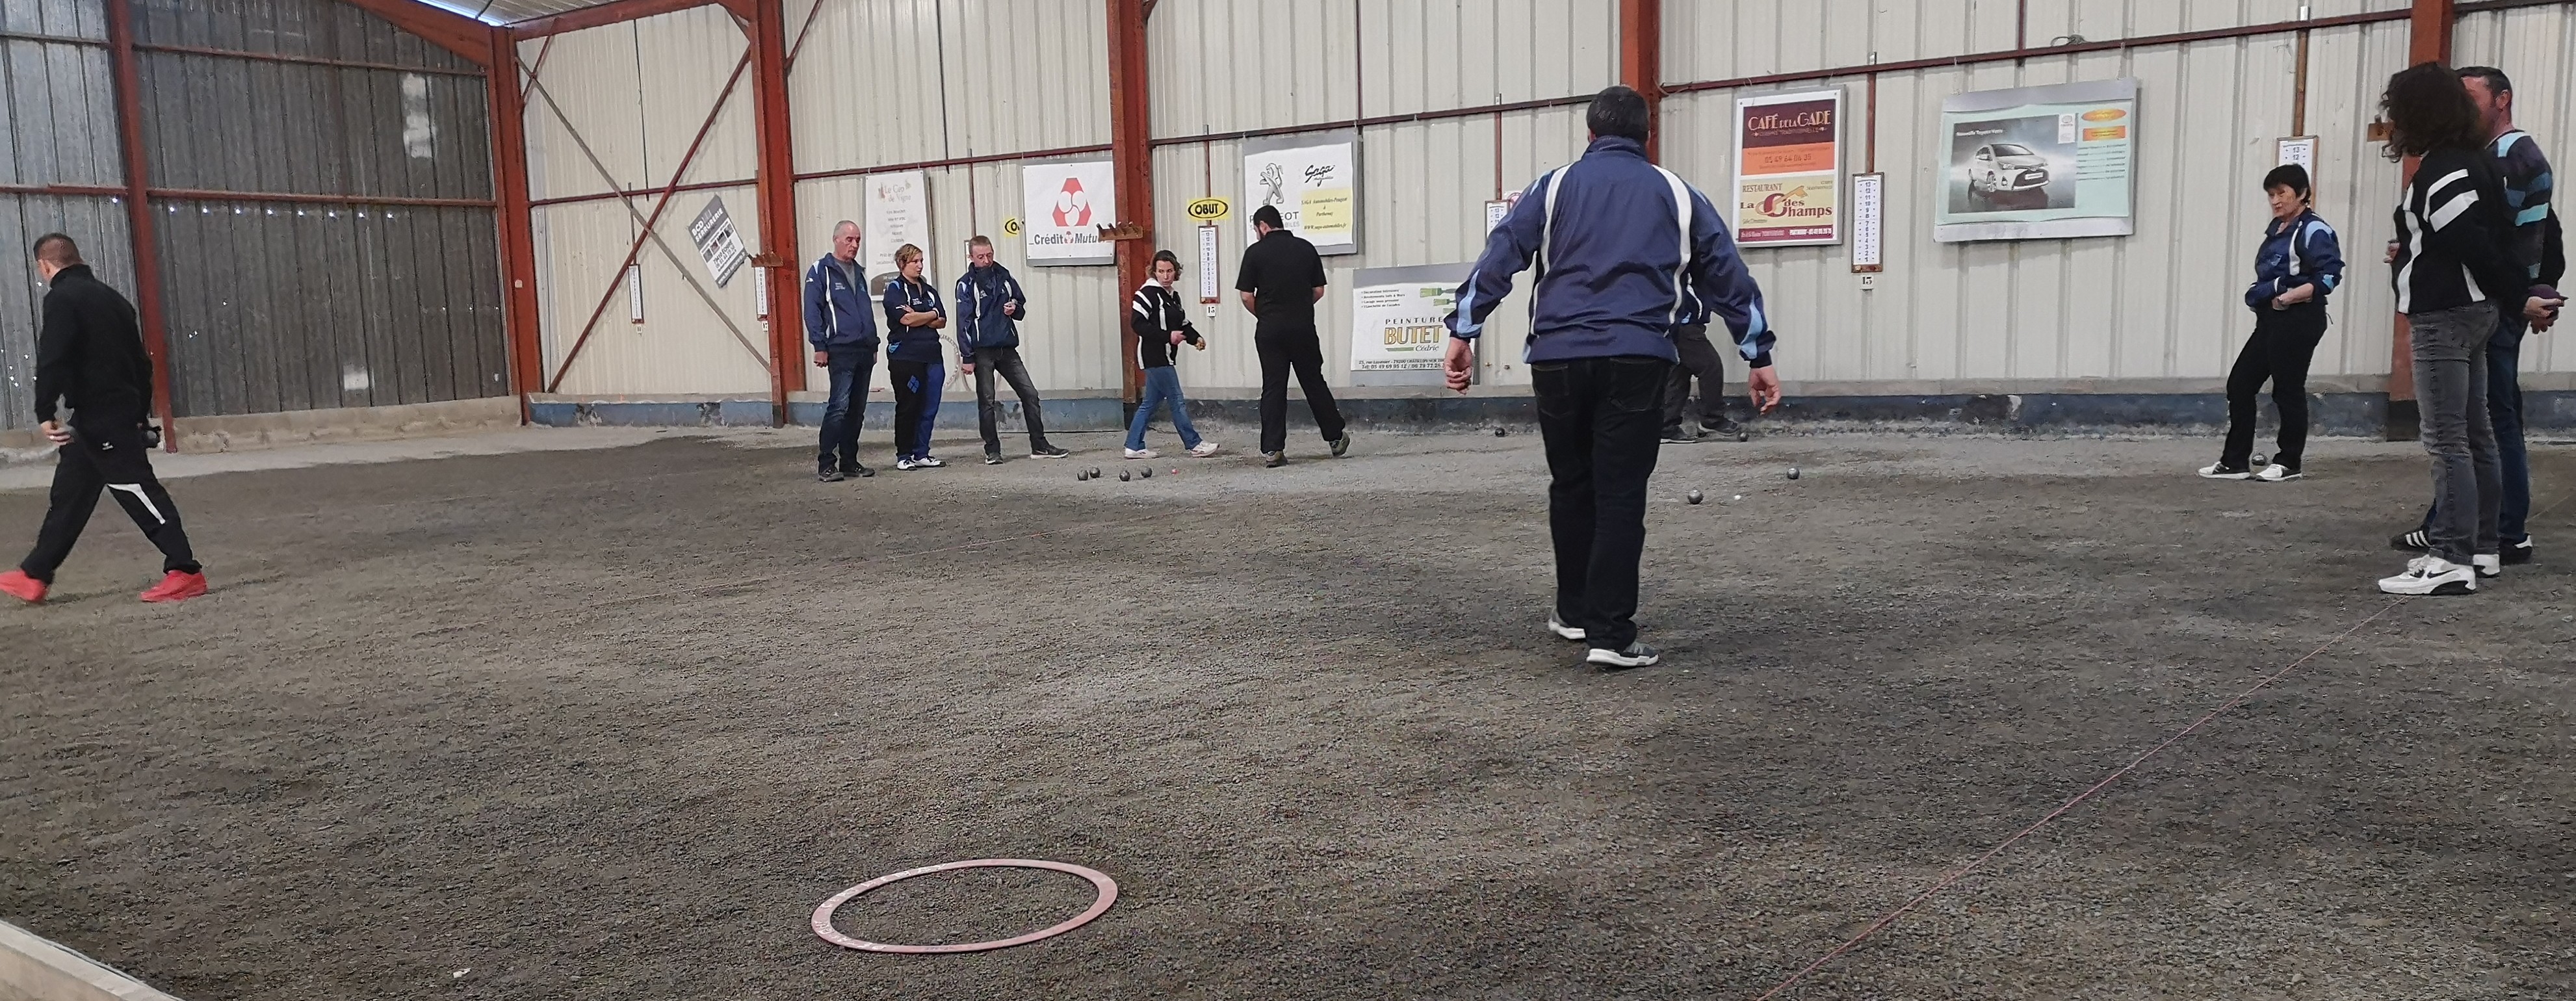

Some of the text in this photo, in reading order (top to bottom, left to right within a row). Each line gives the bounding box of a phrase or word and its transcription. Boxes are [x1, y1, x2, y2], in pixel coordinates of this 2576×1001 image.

[1748, 113, 1778, 130] CAFÉ
[1797, 110, 1831, 126] GARE
[1742, 183, 1783, 192] RESTAURANT
[1195, 203, 1218, 215] OBUT
[695, 207, 723, 243] SERRURERIE
[1250, 212, 1299, 223] PEOT
[691, 219, 704, 237] BCD
[1034, 233, 1105, 244] Crédit Mutu
[1384, 325, 1443, 344] BUTET
